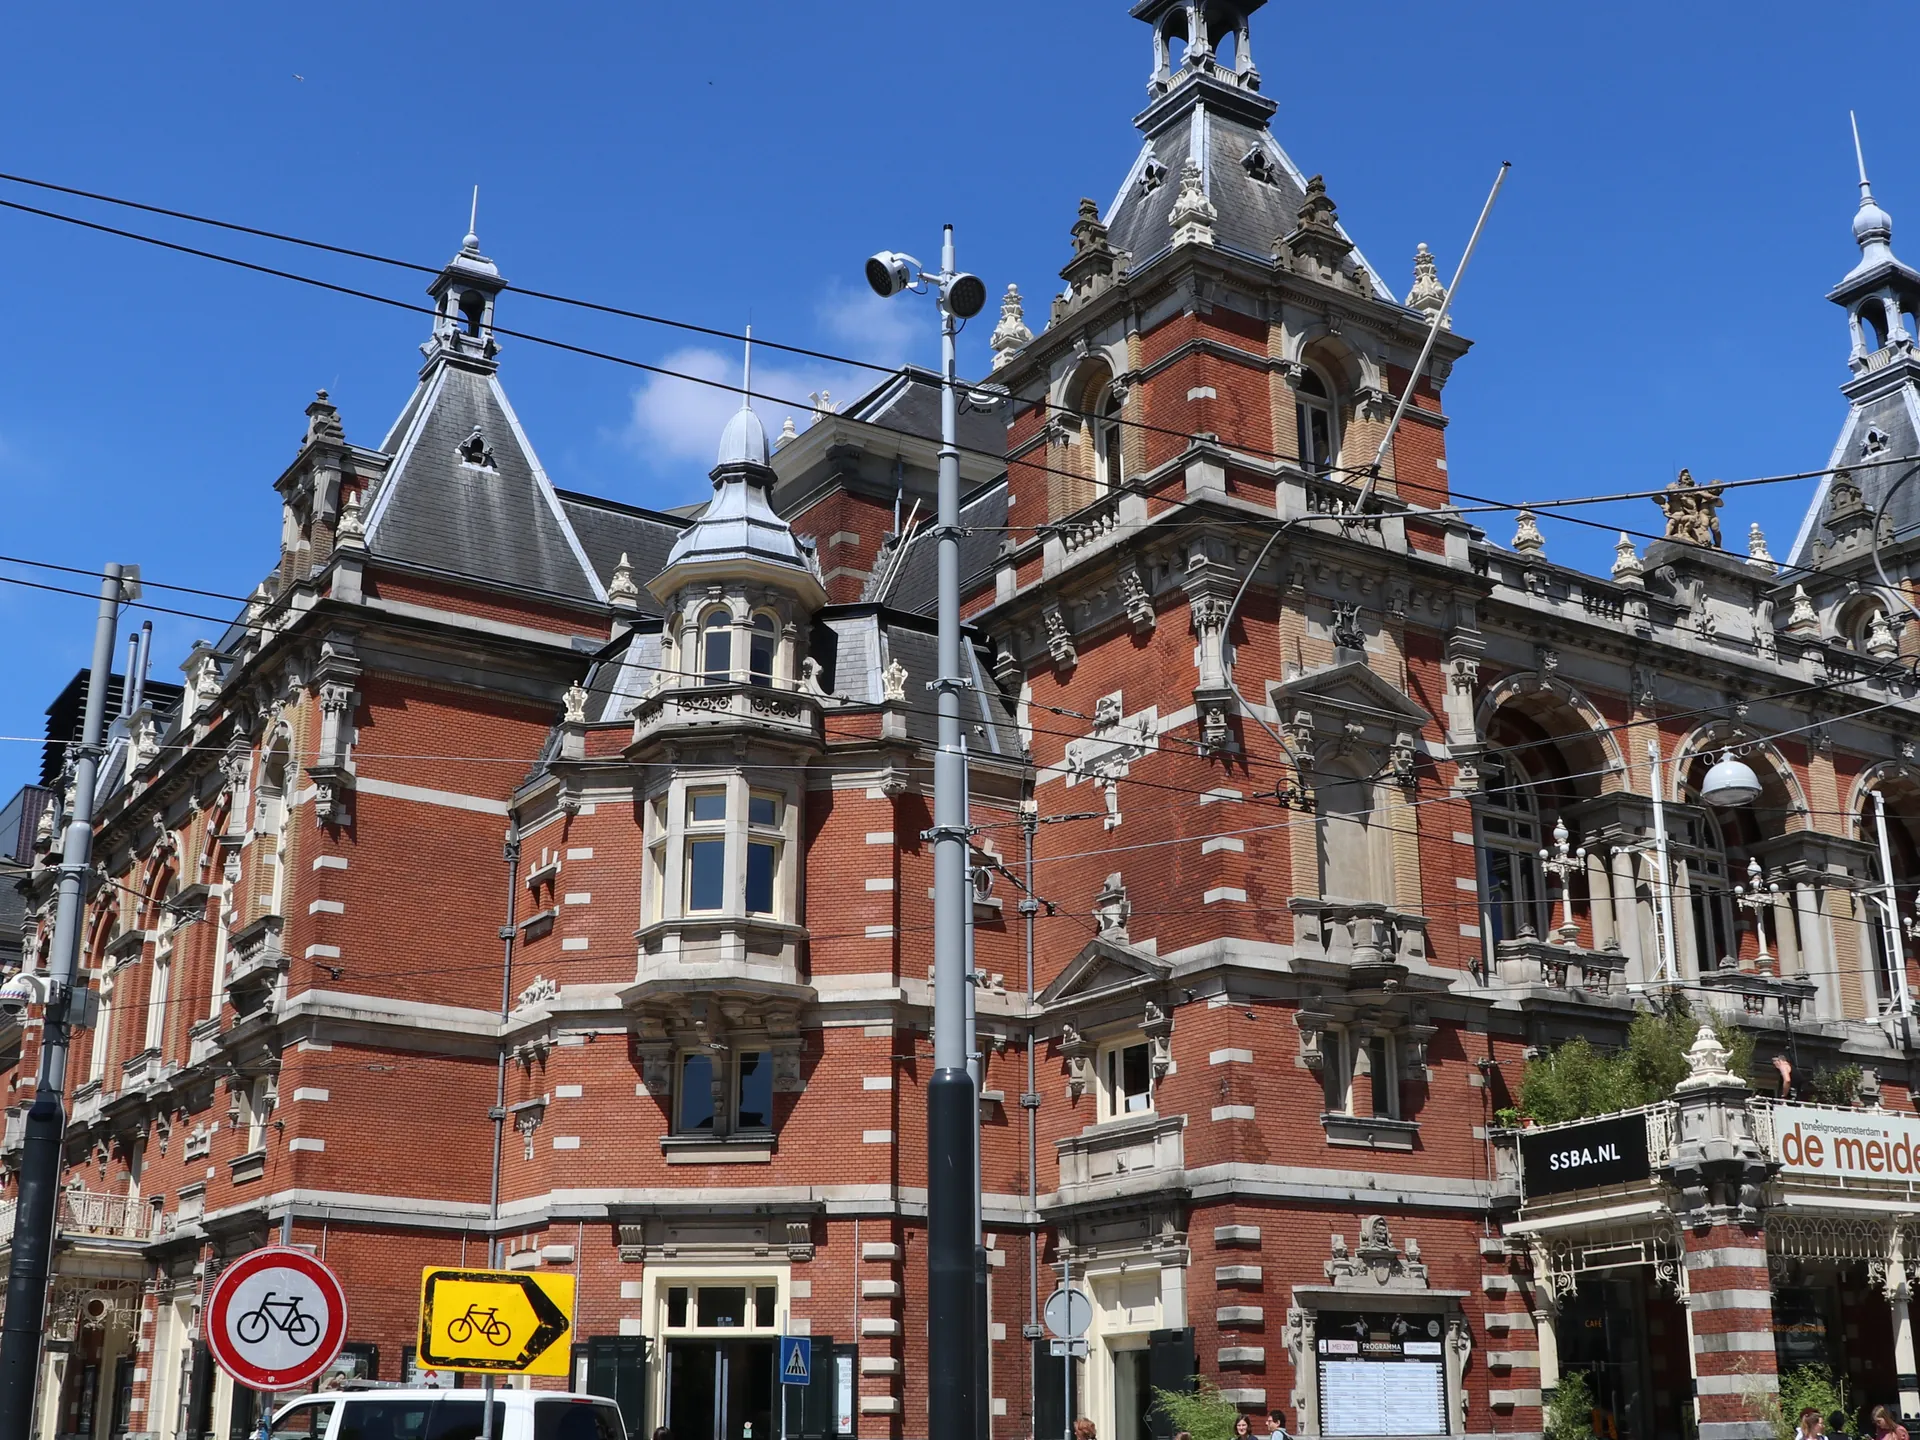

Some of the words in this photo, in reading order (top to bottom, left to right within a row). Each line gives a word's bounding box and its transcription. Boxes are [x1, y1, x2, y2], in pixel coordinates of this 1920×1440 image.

[1801, 1121, 1881, 1137] toneelgroepamsterdam
[1782, 1122, 1824, 1168] de
[1549, 1143, 1621, 1171] SSBA.NL
[1342, 1343, 1355, 1351] 2017
[1362, 1342, 1402, 1350] PROGRAMMA
